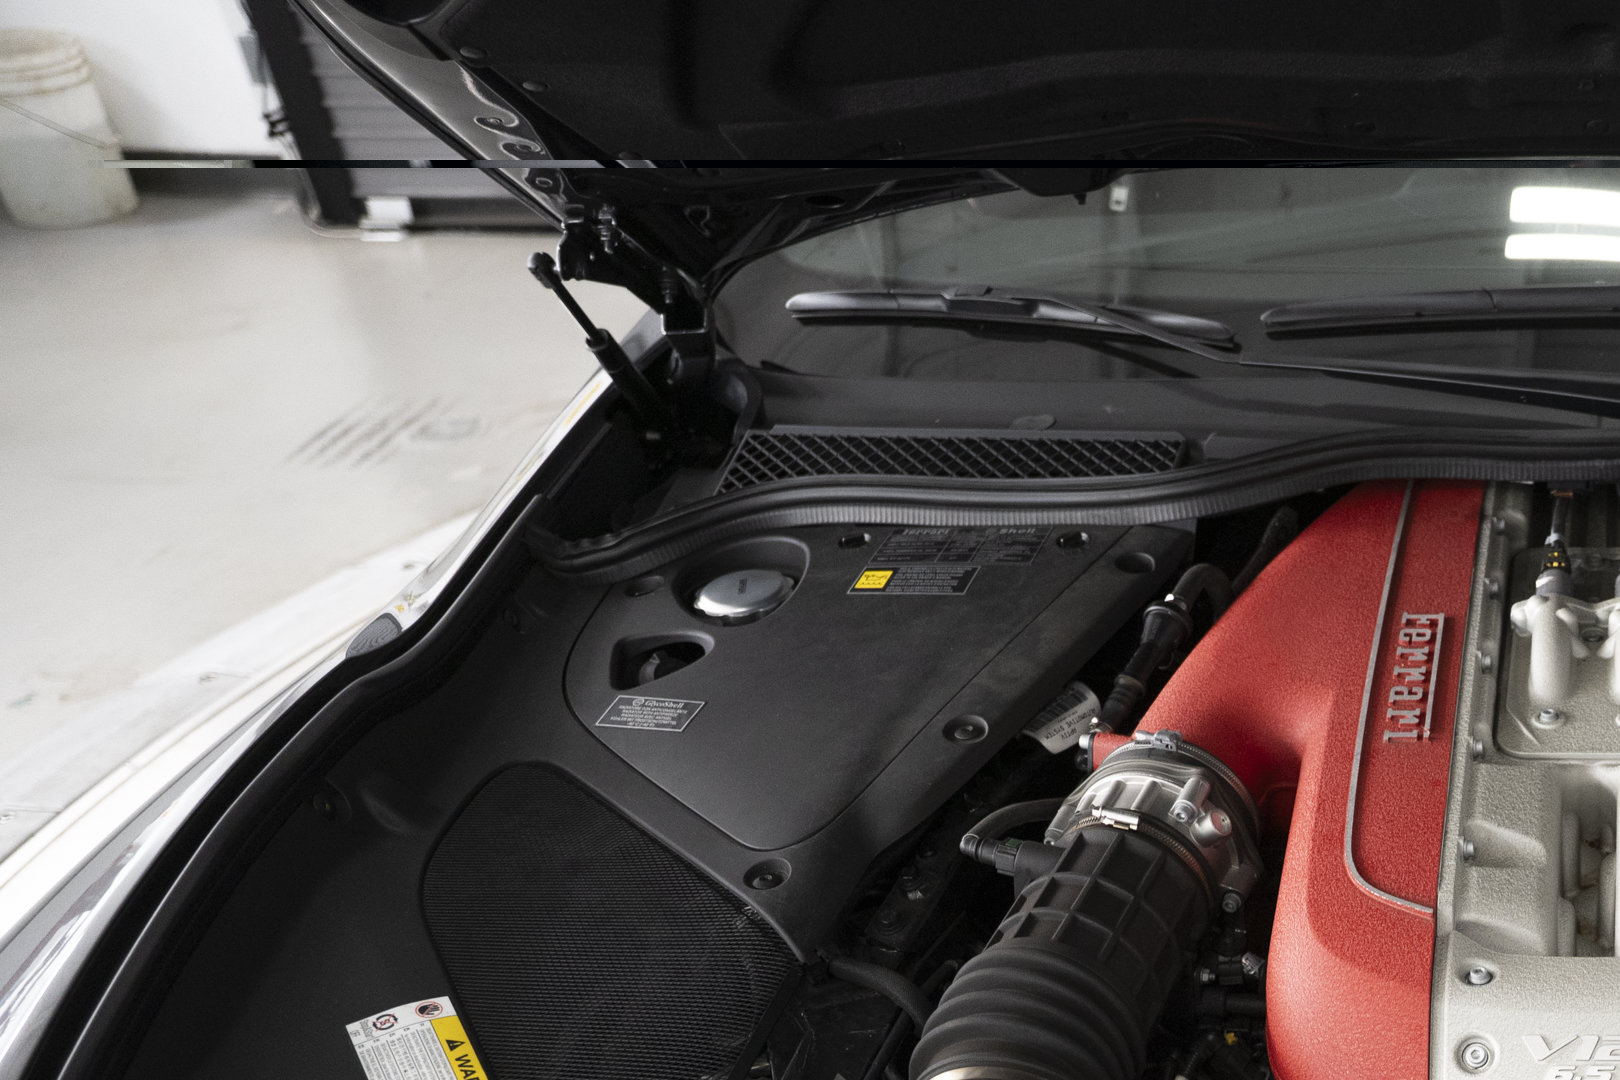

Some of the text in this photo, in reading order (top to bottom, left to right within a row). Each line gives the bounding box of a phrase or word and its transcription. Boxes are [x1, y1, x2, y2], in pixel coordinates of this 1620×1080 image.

[1383, 611, 1445, 744] Ferrari
[645, 700, 684, 709] GlycoShell
[1061, 727, 1078, 740] APTIV
